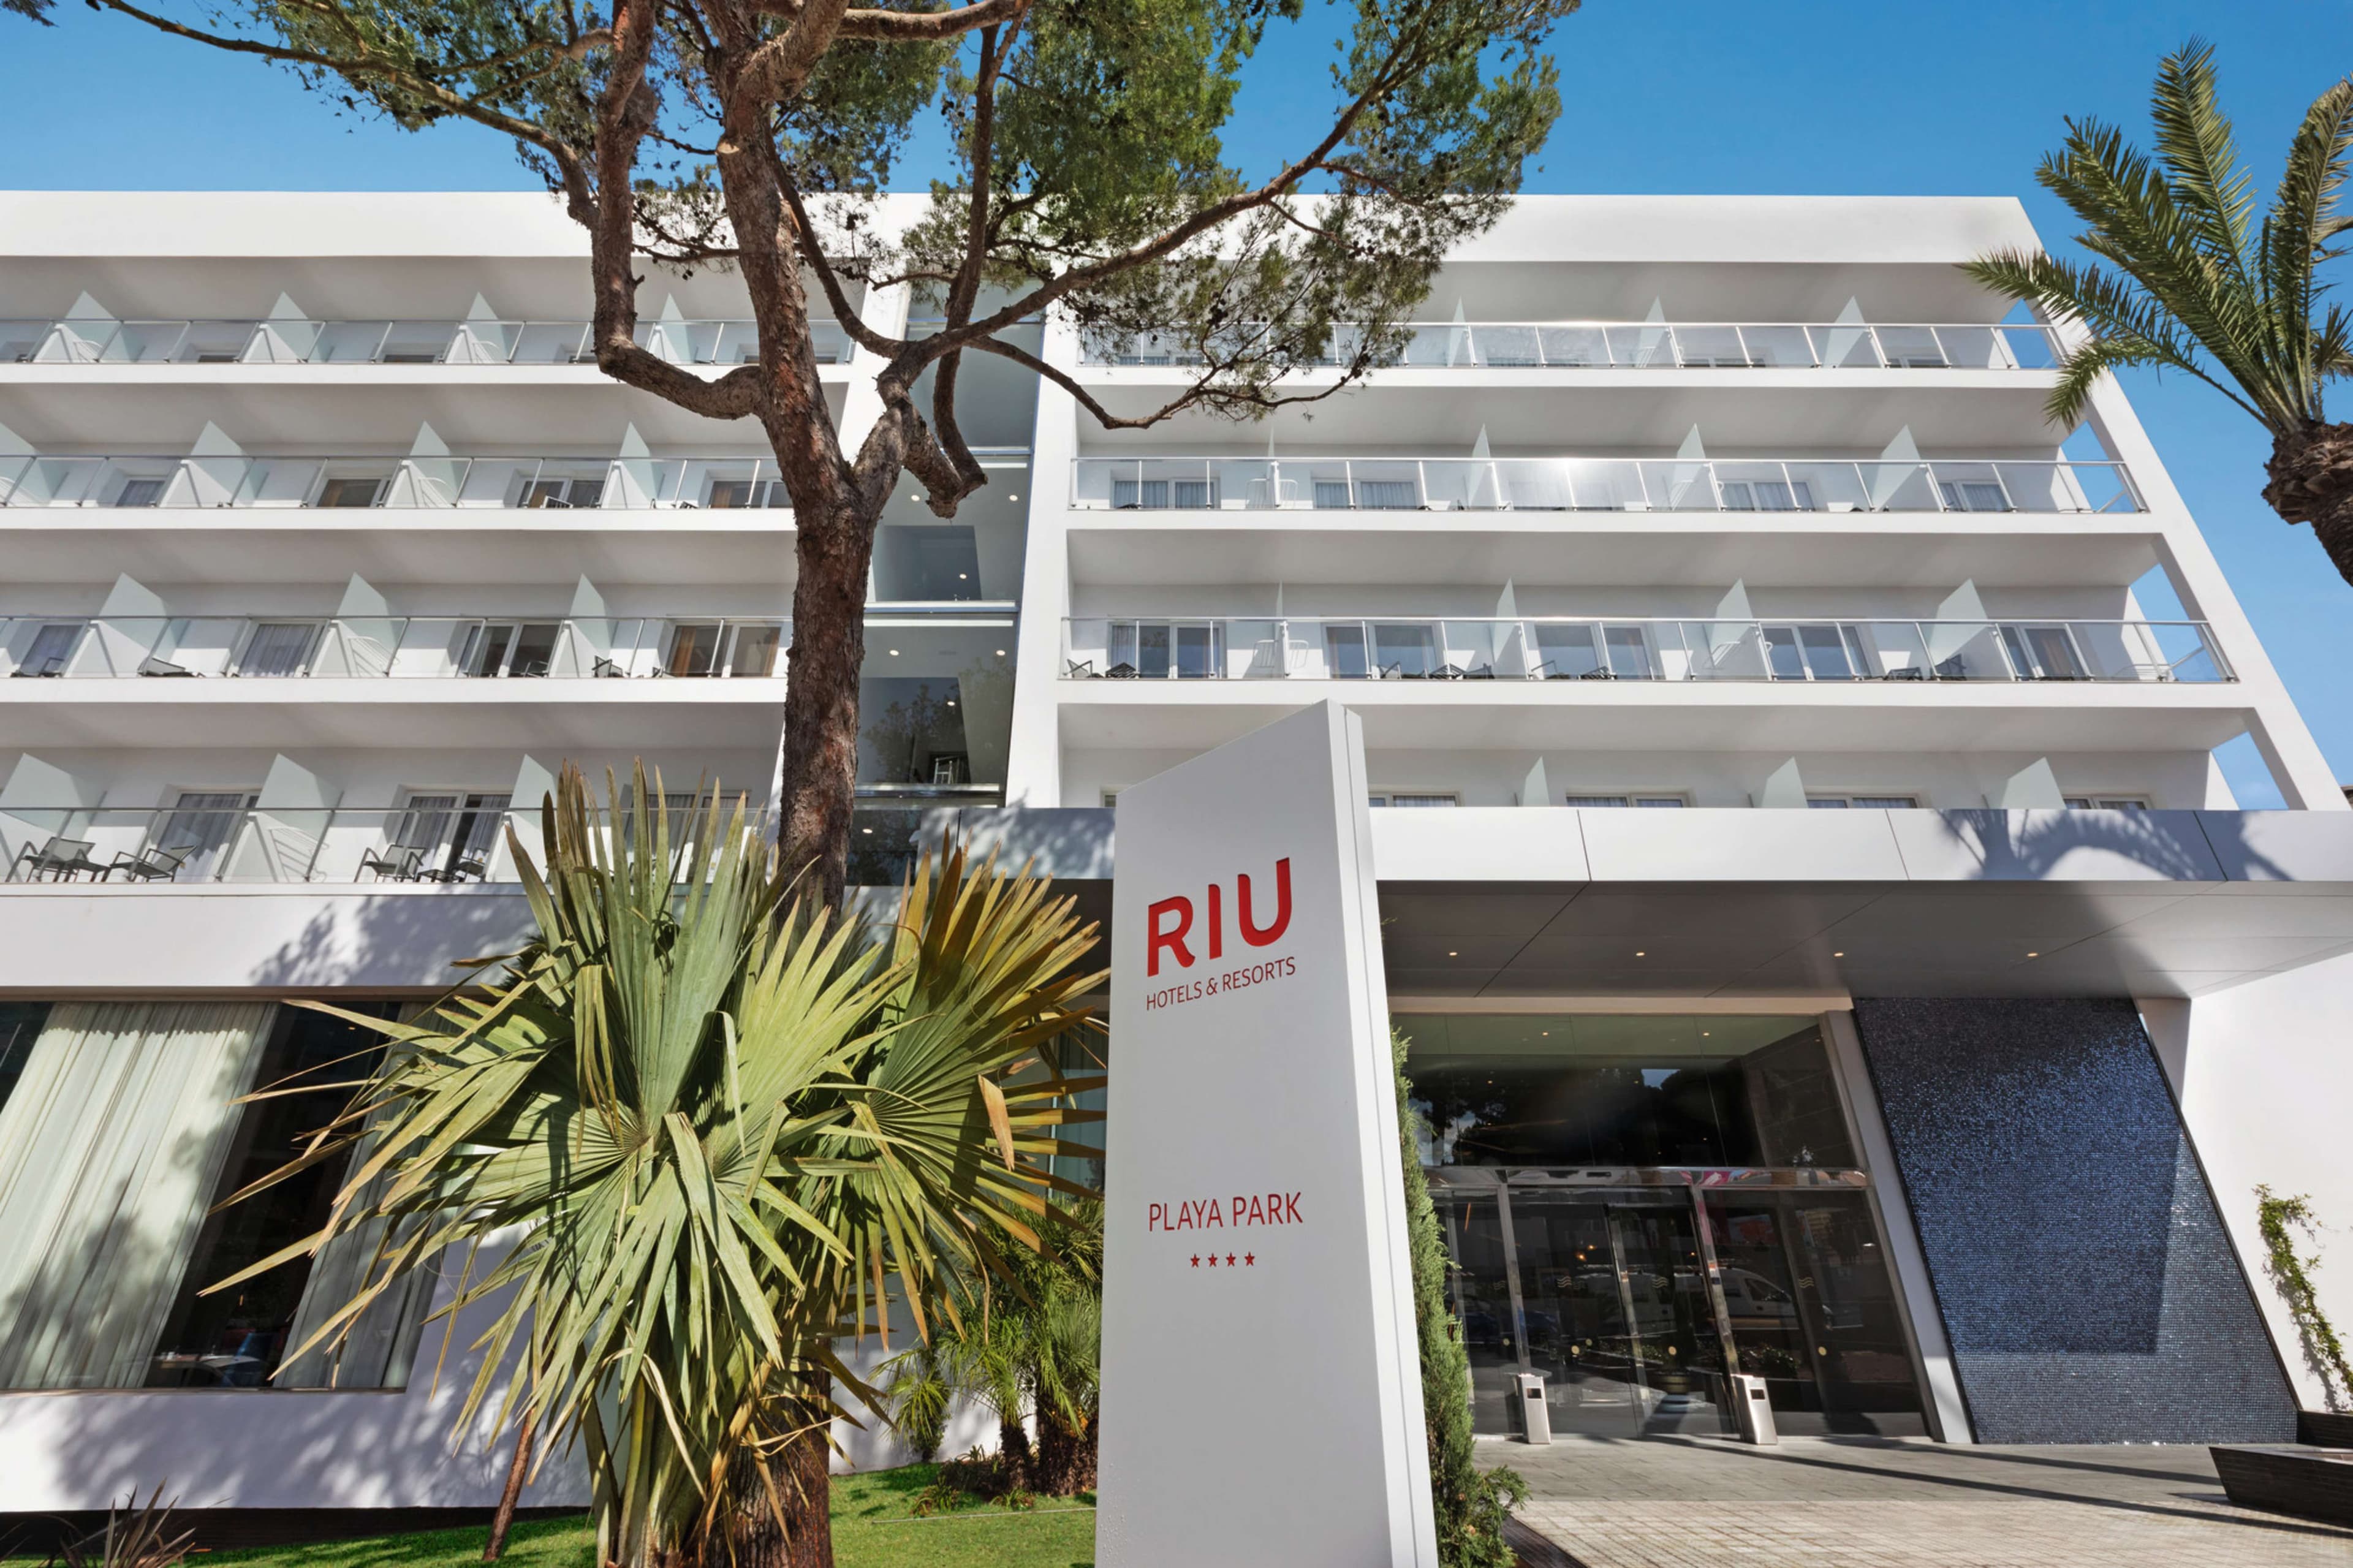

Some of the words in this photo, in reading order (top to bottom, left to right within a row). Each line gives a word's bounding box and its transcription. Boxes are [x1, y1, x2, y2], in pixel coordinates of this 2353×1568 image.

[1146, 857, 1293, 977] RIU
[1146, 981, 1202, 1011] HOTELS
[1206, 977, 1218, 996] &
[1222, 956, 1296, 992] RESORTS
[1149, 1199, 1224, 1232] PLAYA
[1232, 1192, 1303, 1227] PARK
